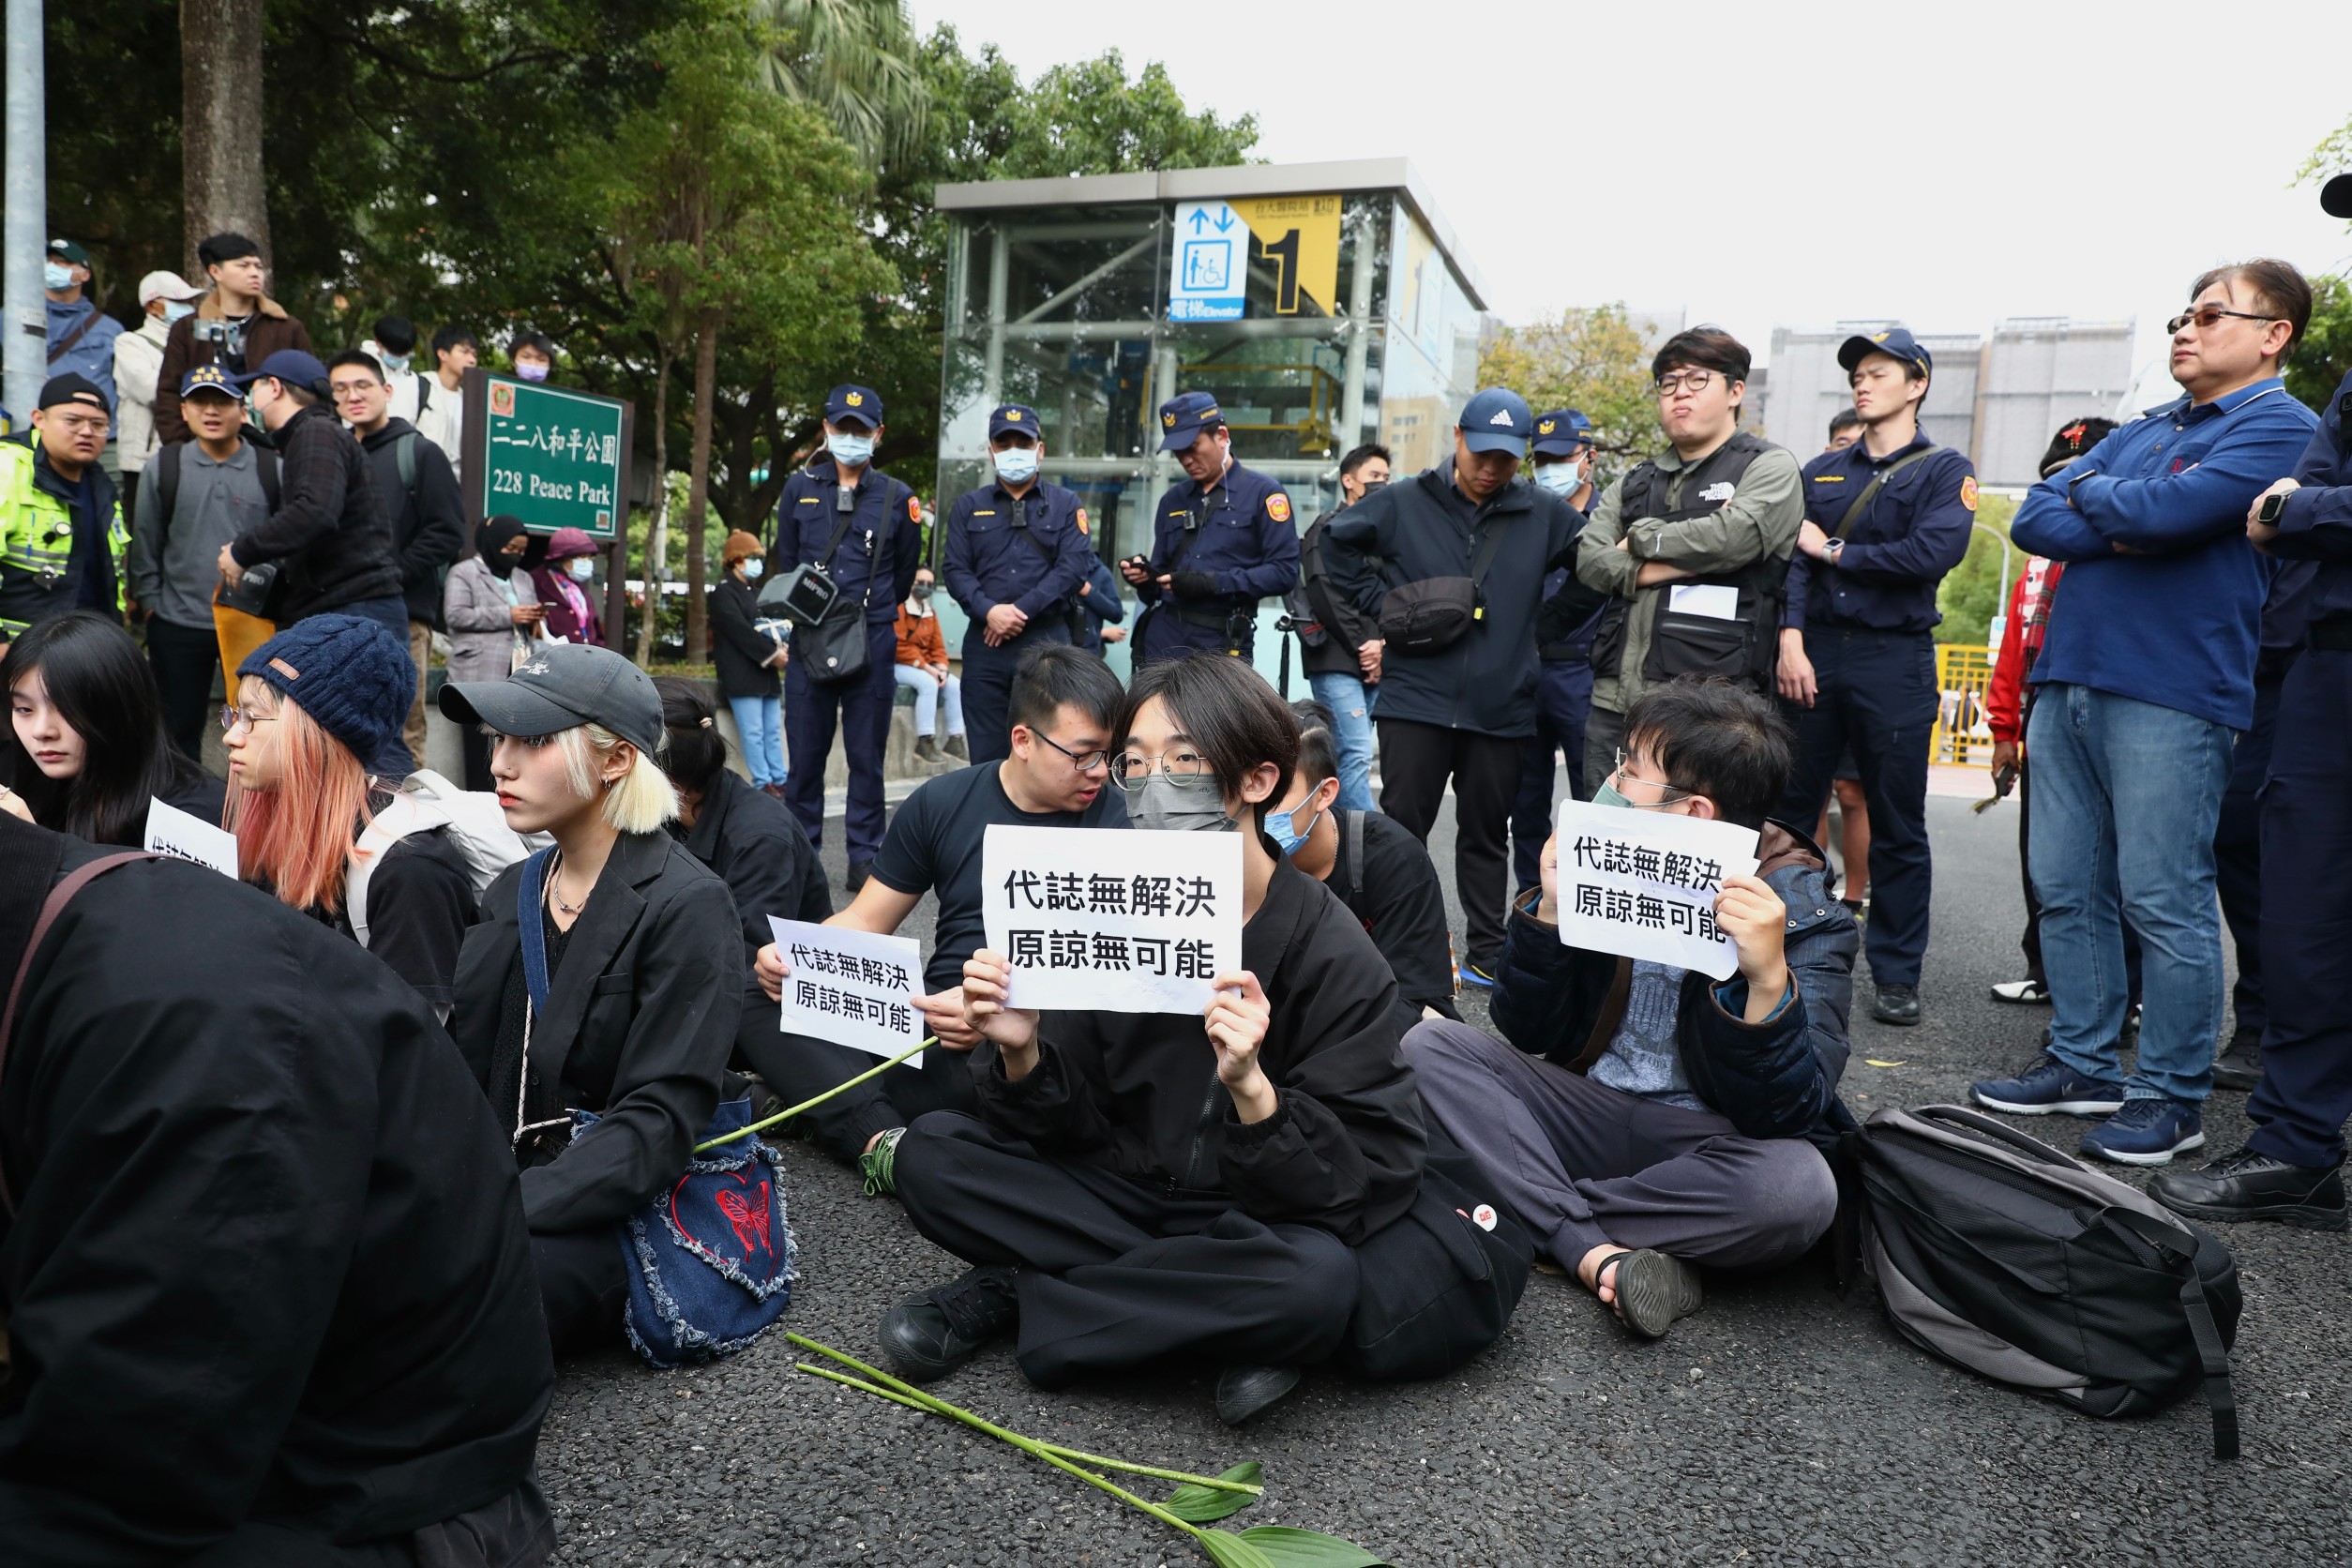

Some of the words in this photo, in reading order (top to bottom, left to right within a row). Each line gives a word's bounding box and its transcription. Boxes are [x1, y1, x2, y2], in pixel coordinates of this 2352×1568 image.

[1265, 228, 1301, 310] 1
[1204, 306, 1243, 318] Elevator
[491, 421, 616, 467] 二二八和平公園
[492, 468, 523, 495] 228
[529, 474, 573, 502] Peace
[579, 480, 611, 506] Park
[802, 577, 829, 600] MIPRO
[1574, 835, 1723, 894] 代誌無解決
[1003, 869, 1216, 917] 代誌無解決
[1575, 883, 1727, 944] 原諒無可能
[791, 942, 911, 993] 代誌無解決
[1008, 928, 1215, 980] 原諒無可能
[795, 979, 912, 1034] 原諒無可能
